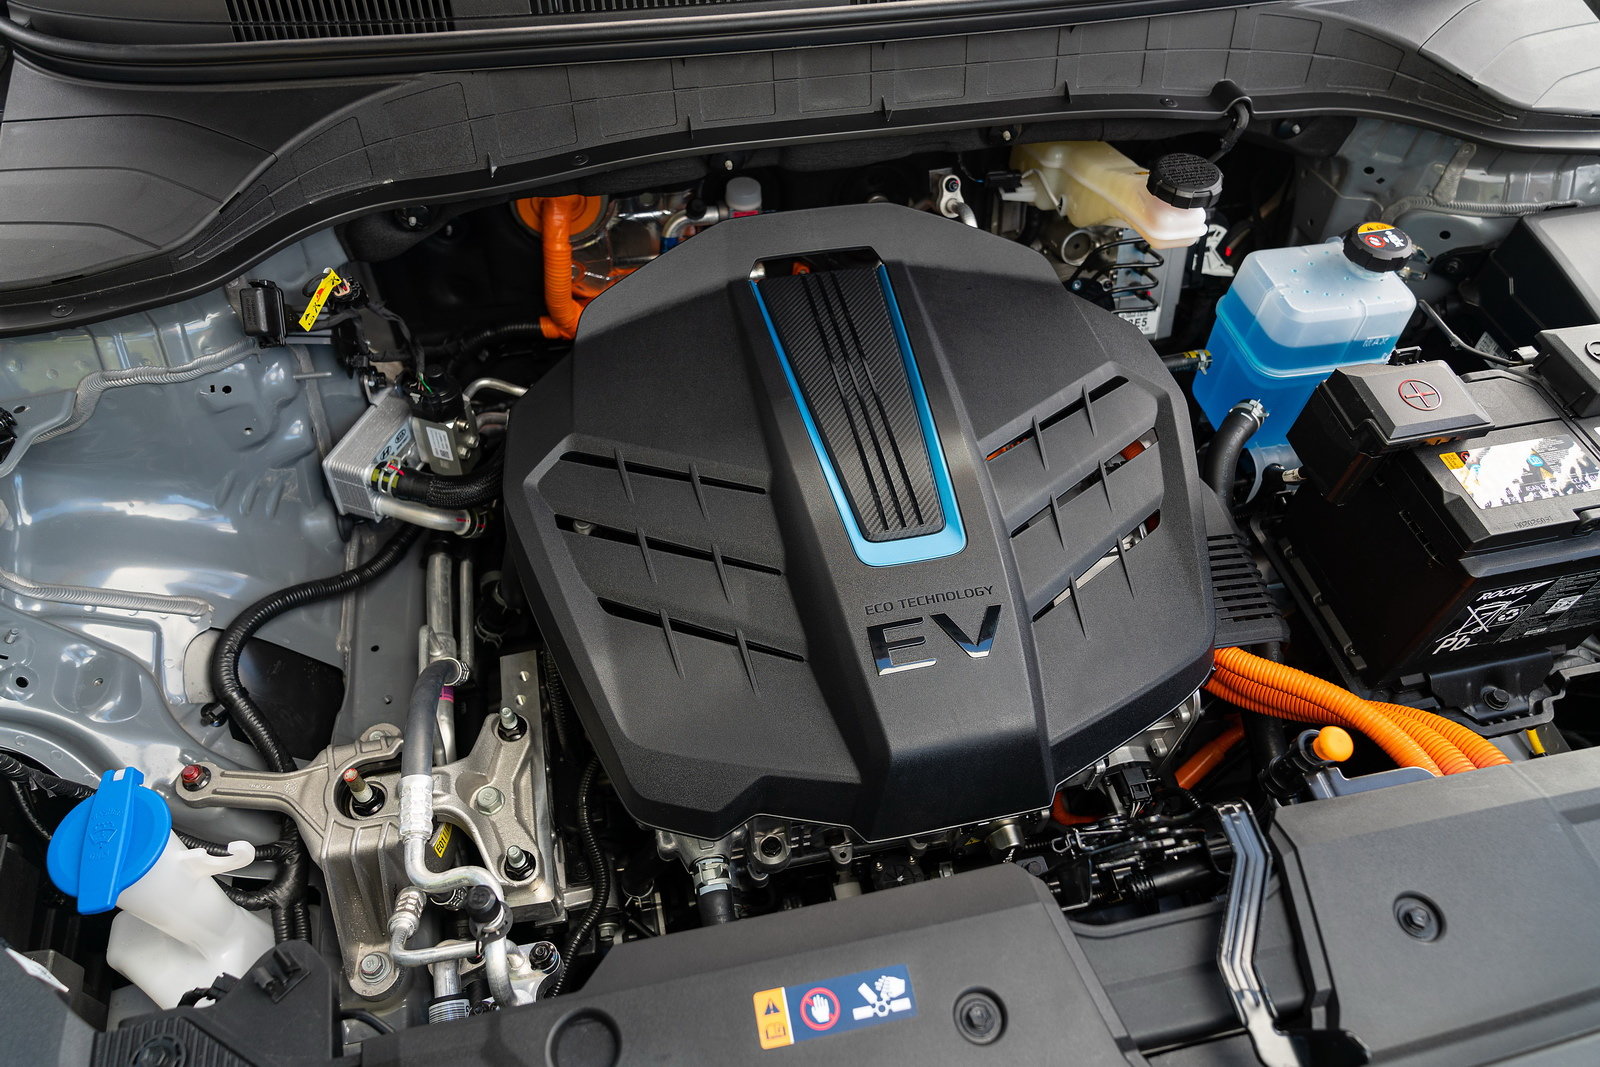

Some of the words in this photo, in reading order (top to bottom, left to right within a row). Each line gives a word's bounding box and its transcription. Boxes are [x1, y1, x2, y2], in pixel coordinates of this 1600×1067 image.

[864, 601, 894, 616] ECO
[898, 585, 993, 609] TECHNOLOGY
[1476, 580, 1555, 602] ROCKET
[866, 604, 1002, 676] EV
[1432, 635, 1471, 655] Pb
